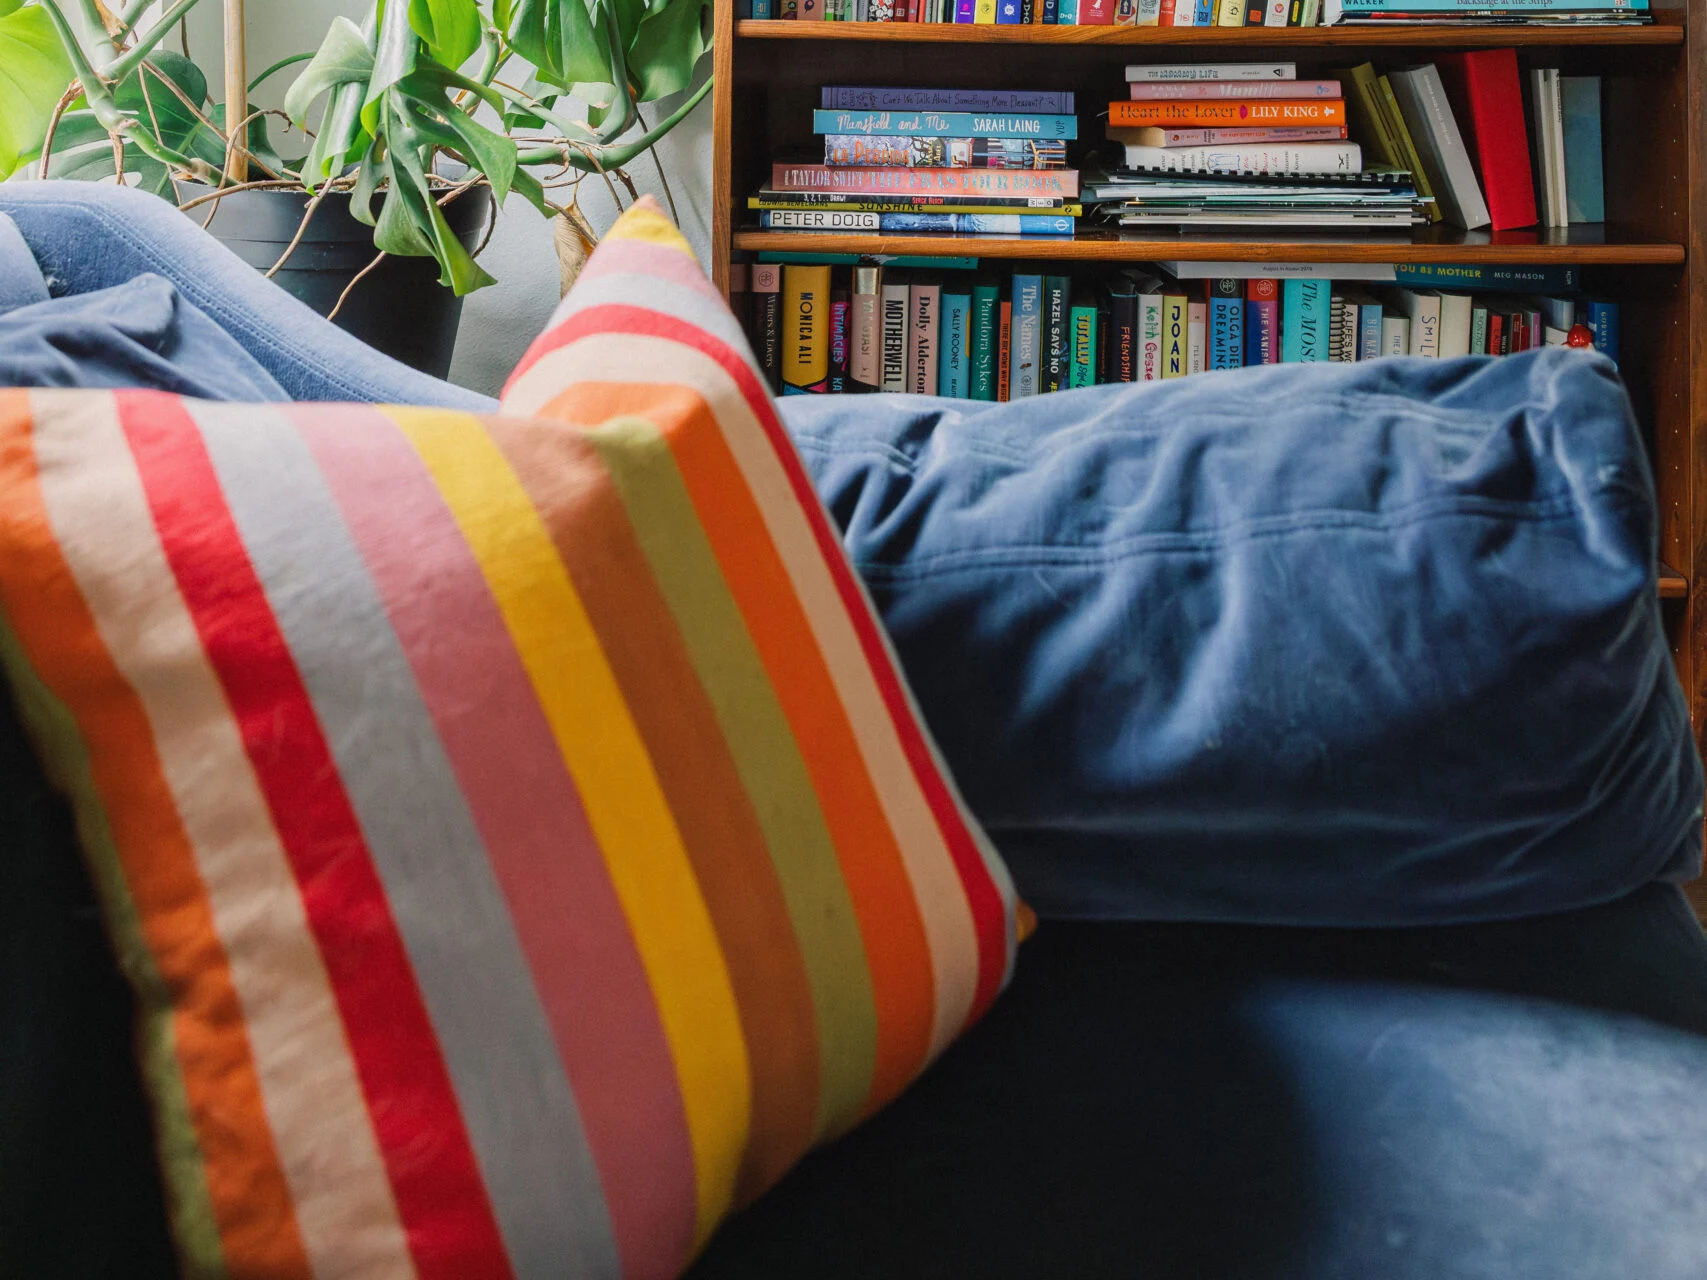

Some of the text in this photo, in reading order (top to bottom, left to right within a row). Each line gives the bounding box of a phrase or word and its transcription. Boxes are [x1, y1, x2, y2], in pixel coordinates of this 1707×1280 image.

[837, 112, 1040, 134] Mansfield and Me SARAH LAING
[1056, 120, 1065, 136] VUP
[1120, 104, 1318, 118] Heart the Lover LILY KING
[833, 148, 848, 163] LA
[792, 170, 1063, 192] TAYLOR SWIFT THE ERAS TOUR BOOK
[772, 212, 874, 227] PETER DOIG
[858, 203, 922, 212] SUNSHINE
[1420, 266, 1432, 274] BE
[1437, 267, 1481, 278] MOTHER
[1514, 272, 1545, 280] MASON
[1261, 307, 1269, 325] THE
[1301, 283, 1317, 312] The
[766, 295, 776, 368] Writers Lovers
[798, 292, 813, 364] MONICA ALI
[833, 304, 844, 363] INTIMACIES
[884, 300, 904, 384] MOTHERWELL
[951, 308, 960, 370] SALLY ROONEY
[1020, 285, 1037, 360] The Names
[1051, 290, 1061, 373] HAZEL SAYS NO
[1076, 315, 1090, 365] TOTALLY
[1145, 306, 1160, 339] Keith
[1170, 306, 1181, 374] JOAN
[1229, 306, 1239, 370] OLGA DIES
[1366, 319, 1377, 335] BIG
[916, 296, 930, 394] Dolly Alderton
[976, 298, 993, 391] Pandora Sykes
